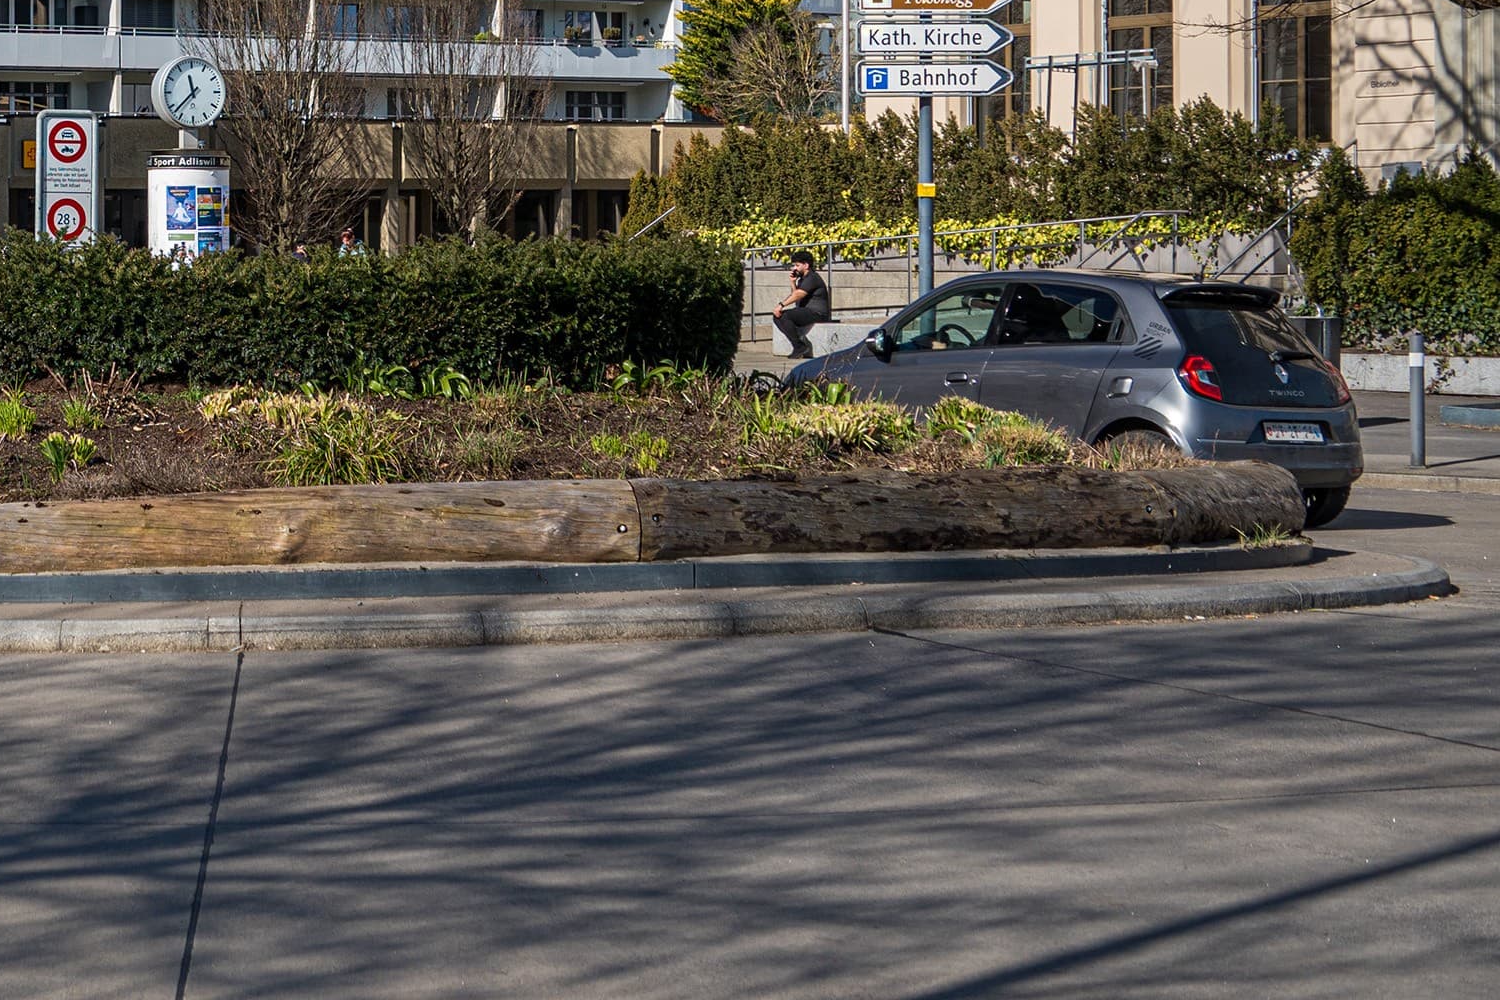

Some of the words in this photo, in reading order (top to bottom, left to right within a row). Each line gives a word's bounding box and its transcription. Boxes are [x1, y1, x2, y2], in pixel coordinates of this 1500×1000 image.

[869, 28, 916, 45] Kath.
[925, 28, 982, 45] Kirche
[900, 68, 977, 86] Bahnhof
[154, 158, 175, 167] Sport
[179, 158, 216, 166] Adliswil
[57, 214, 70, 225] 28
[73, 217, 76, 225] t
[1149, 322, 1172, 335] URBAN
